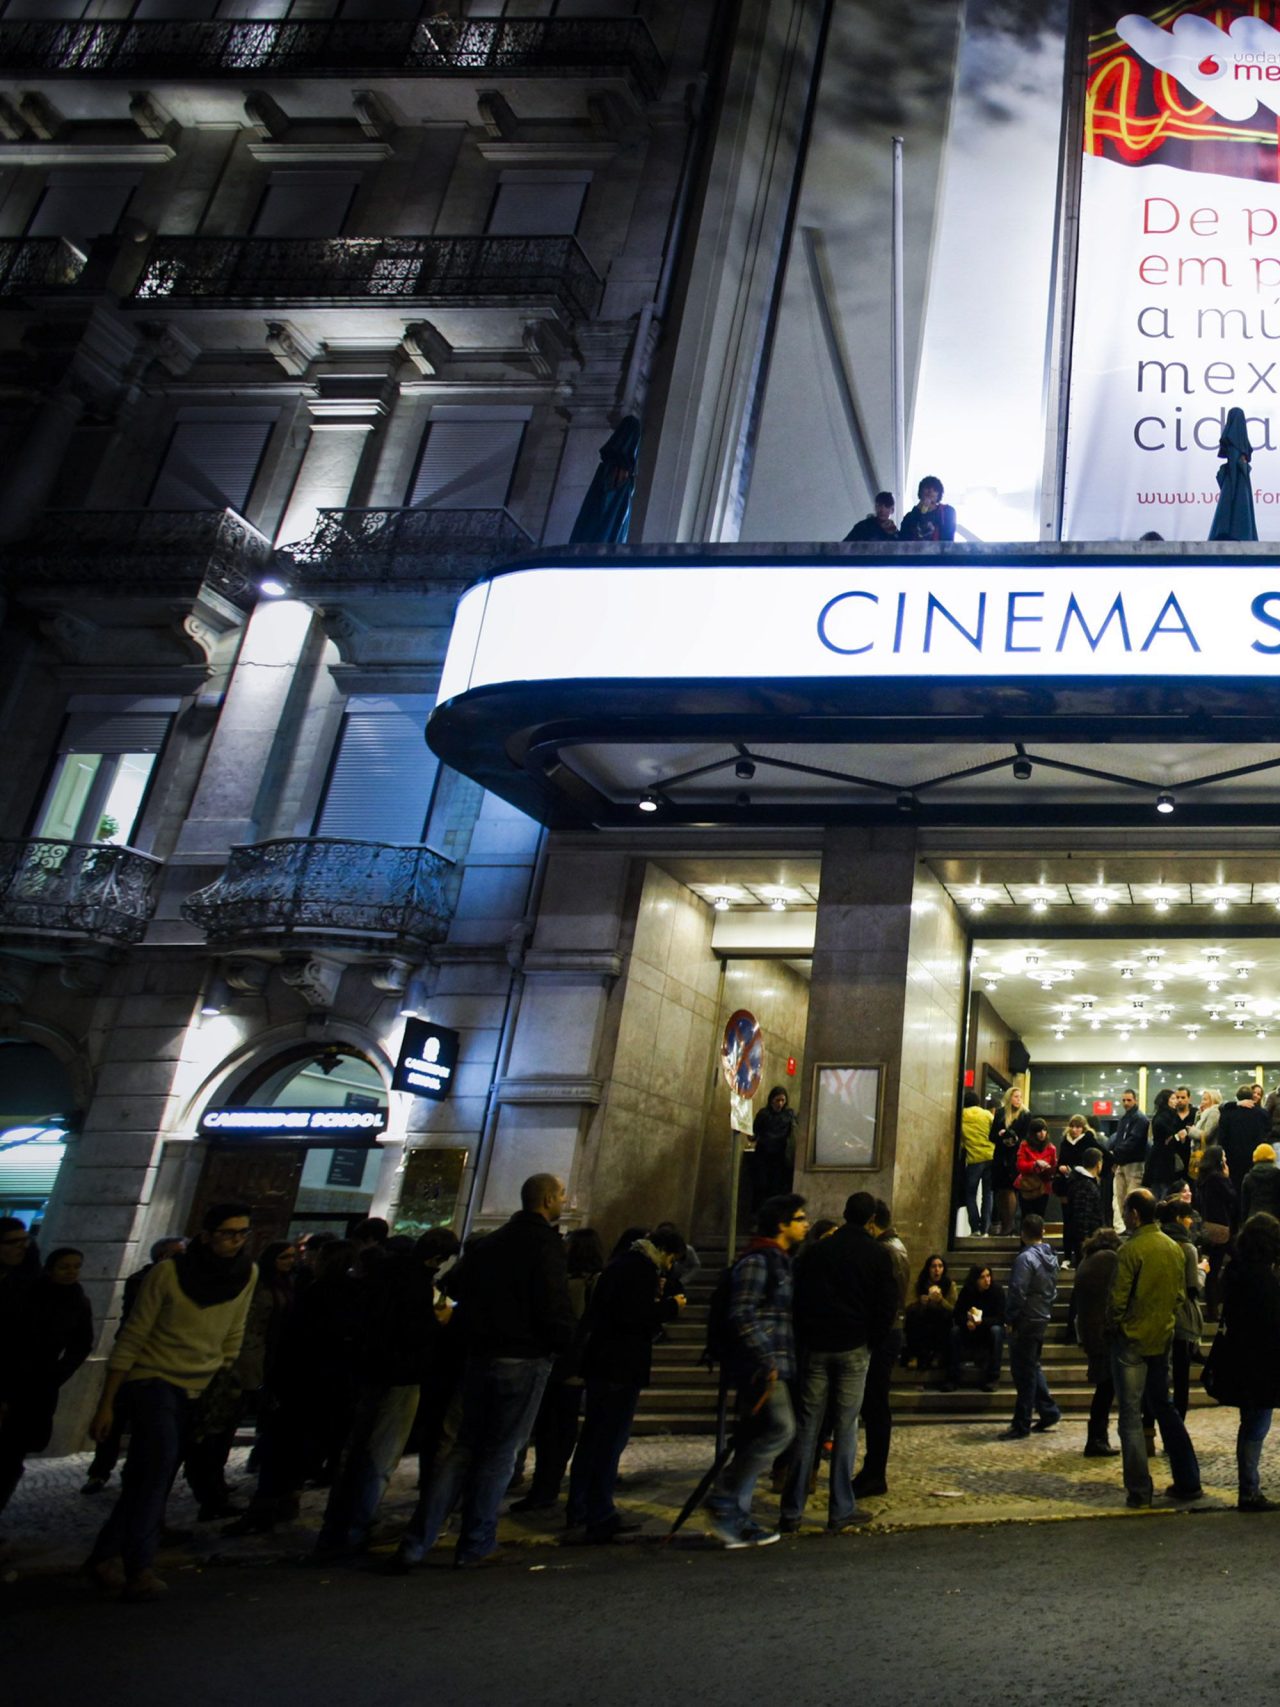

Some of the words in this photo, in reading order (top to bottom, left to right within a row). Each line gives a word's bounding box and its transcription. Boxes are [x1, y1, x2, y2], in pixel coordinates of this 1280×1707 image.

[1143, 197, 1220, 235] De
[1139, 254, 1232, 287] em
[1137, 305, 1174, 339] a
[817, 590, 1202, 654] CINEMA
[310, 1112, 384, 1128] SCHOOL
